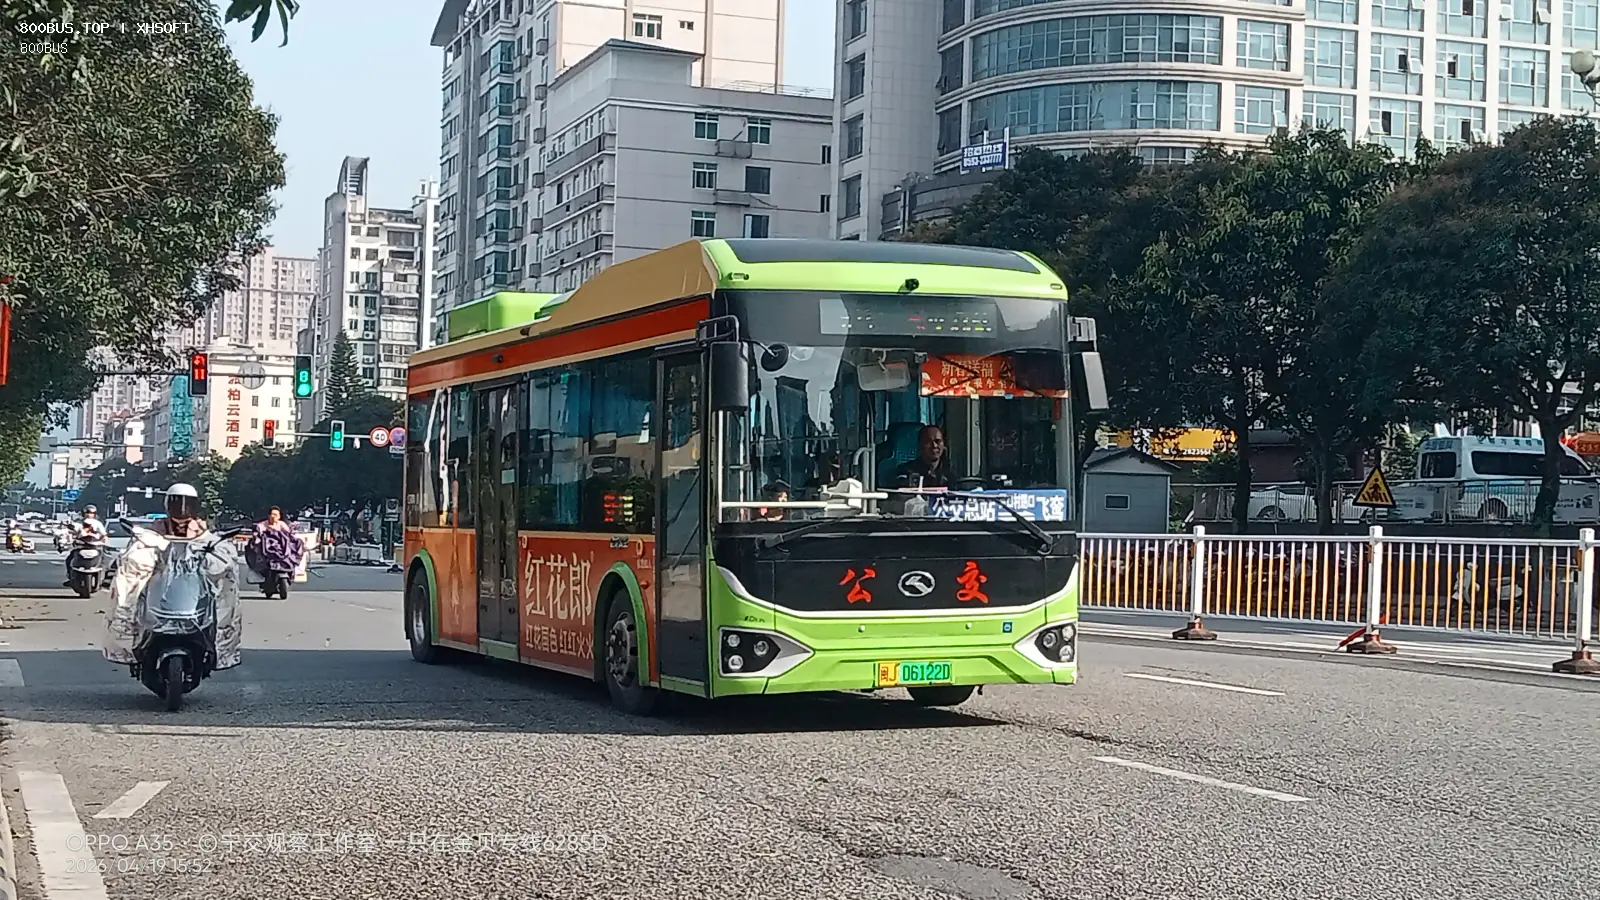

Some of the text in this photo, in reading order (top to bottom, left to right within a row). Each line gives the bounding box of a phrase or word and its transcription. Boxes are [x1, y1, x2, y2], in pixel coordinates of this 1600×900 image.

[194, 368, 205, 380] 11
[374, 433, 386, 443] 40
[932, 497, 996, 522] 公交总站
[524, 551, 593, 626] 红花郎
[839, 560, 989, 604] 公 交
